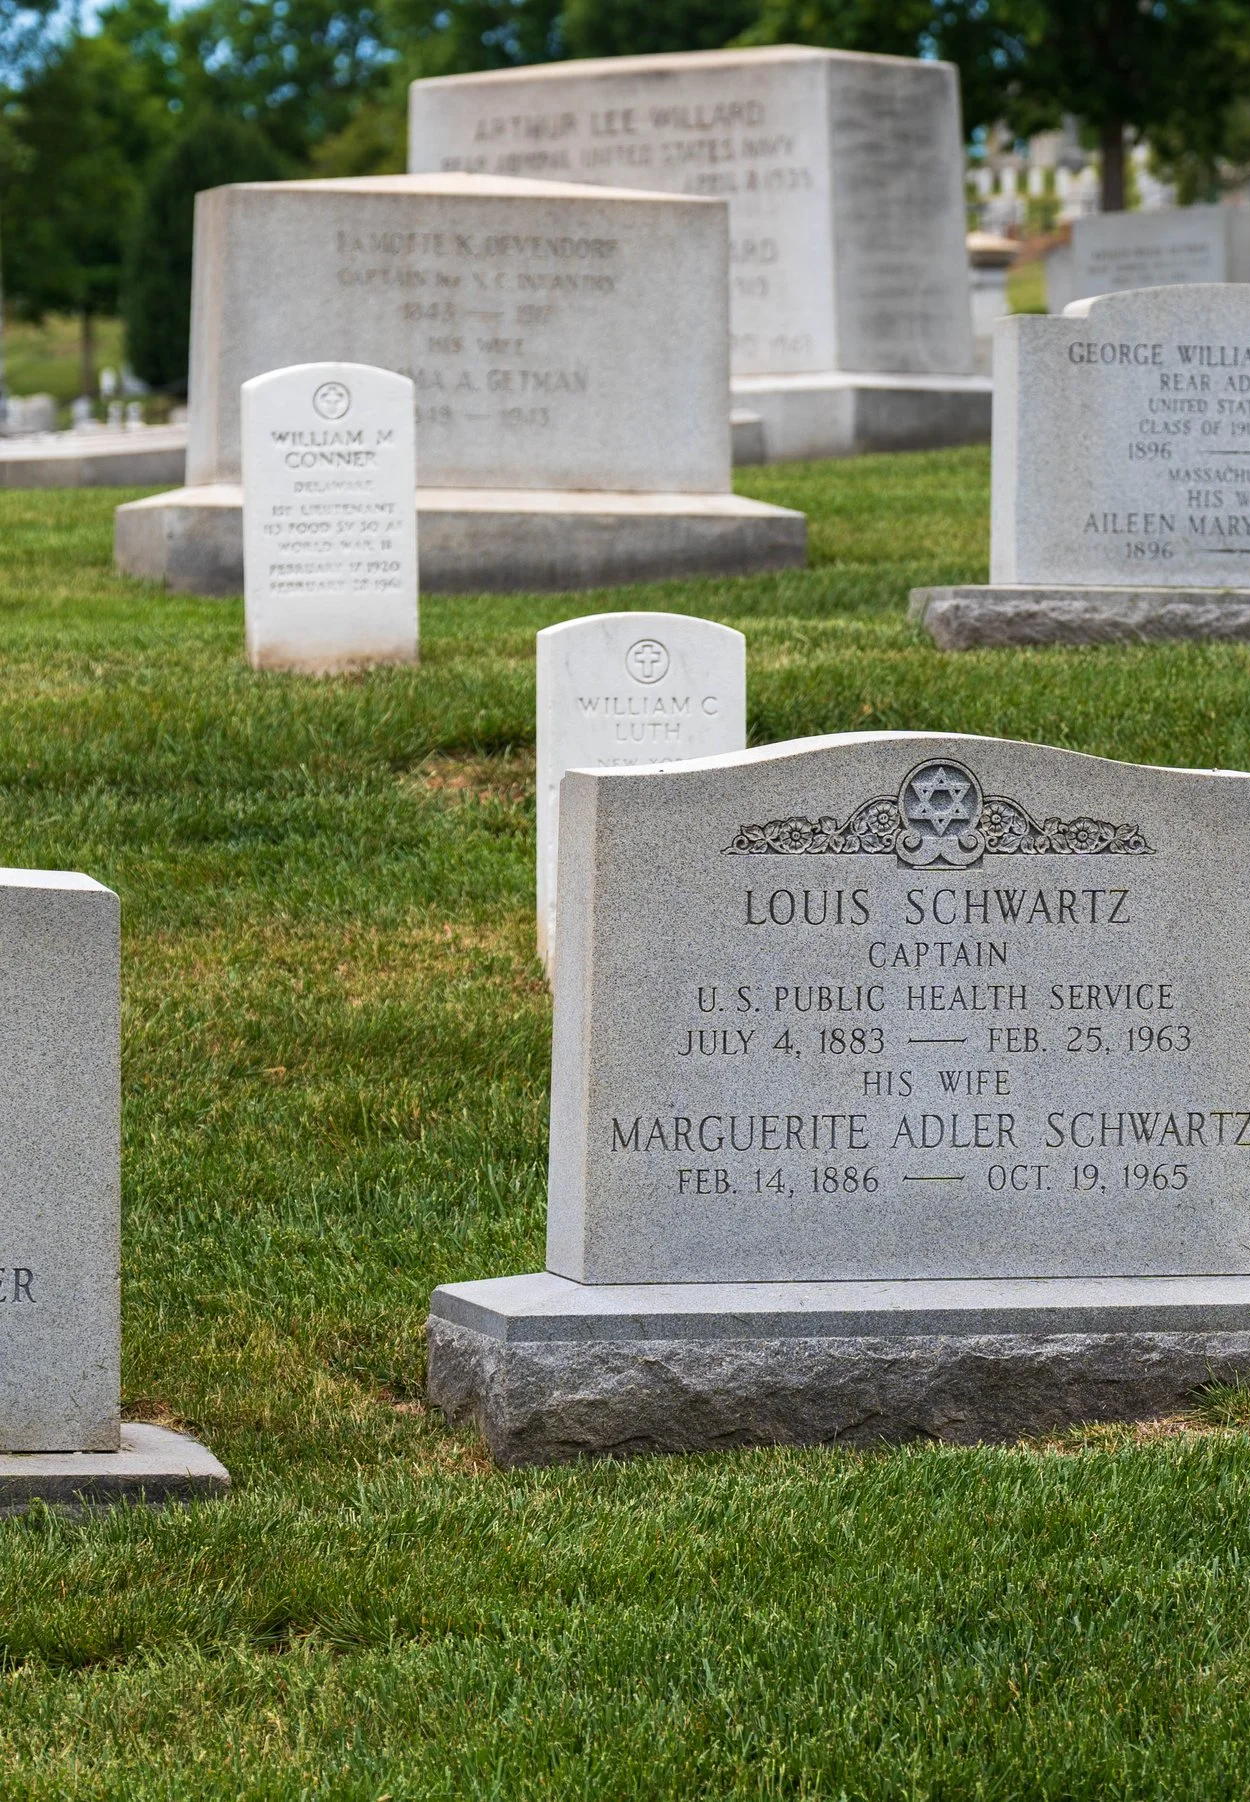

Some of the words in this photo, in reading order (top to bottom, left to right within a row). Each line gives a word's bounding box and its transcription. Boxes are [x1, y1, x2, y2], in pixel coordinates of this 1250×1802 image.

[591, 108, 635, 136] LEE
[649, 100, 766, 131] WILLARD
[661, 138, 735, 164] STATES
[429, 335, 465, 353] HIS
[1068, 342, 1164, 366] GEORGE
[486, 368, 590, 394] GETMAN
[1160, 373, 1212, 392] REAR
[1148, 398, 1209, 414] UNITED
[270, 429, 364, 447] WILLIAM
[376, 429, 394, 446] M
[1138, 418, 1193, 436] CLASS
[1200, 419, 1222, 436] OF
[284, 450, 378, 469] CONNER
[1128, 441, 1172, 462] 1896
[1187, 489, 1224, 508] HIS
[1083, 511, 1175, 535] AILEEN
[1125, 540, 1175, 561] 1896
[578, 696, 691, 716] WILLIAM
[701, 695, 719, 716] C
[616, 722, 681, 742] LUTH
[744, 888, 871, 926] LOUIS
[904, 888, 1130, 926] SCHWARTZ
[868, 941, 1009, 969] CAPTAIN
[774, 985, 886, 1012] PUBLIC
[906, 984, 1030, 1012] HEALTH
[1049, 983, 1175, 1012] SERVICE
[678, 1029, 754, 1058] JULY
[773, 1029, 802, 1061] 4,
[819, 1027, 886, 1055] 1883
[987, 1026, 1049, 1054] FEB.
[1066, 1026, 1113, 1058] 25,
[1127, 1025, 1192, 1053] 1963
[862, 1071, 912, 1098] HIS
[938, 1070, 1011, 1097] WIFE
[611, 1114, 870, 1153] MARGUERITE
[891, 1112, 1016, 1150] ADLER
[677, 1167, 739, 1196] FEB.
[754, 1167, 794, 1199] 14,
[811, 1166, 880, 1194] 1886
[987, 1165, 1053, 1193] OCT.
[1071, 1164, 1109, 1197] 19,
[1122, 1164, 1189, 1192] 1965
